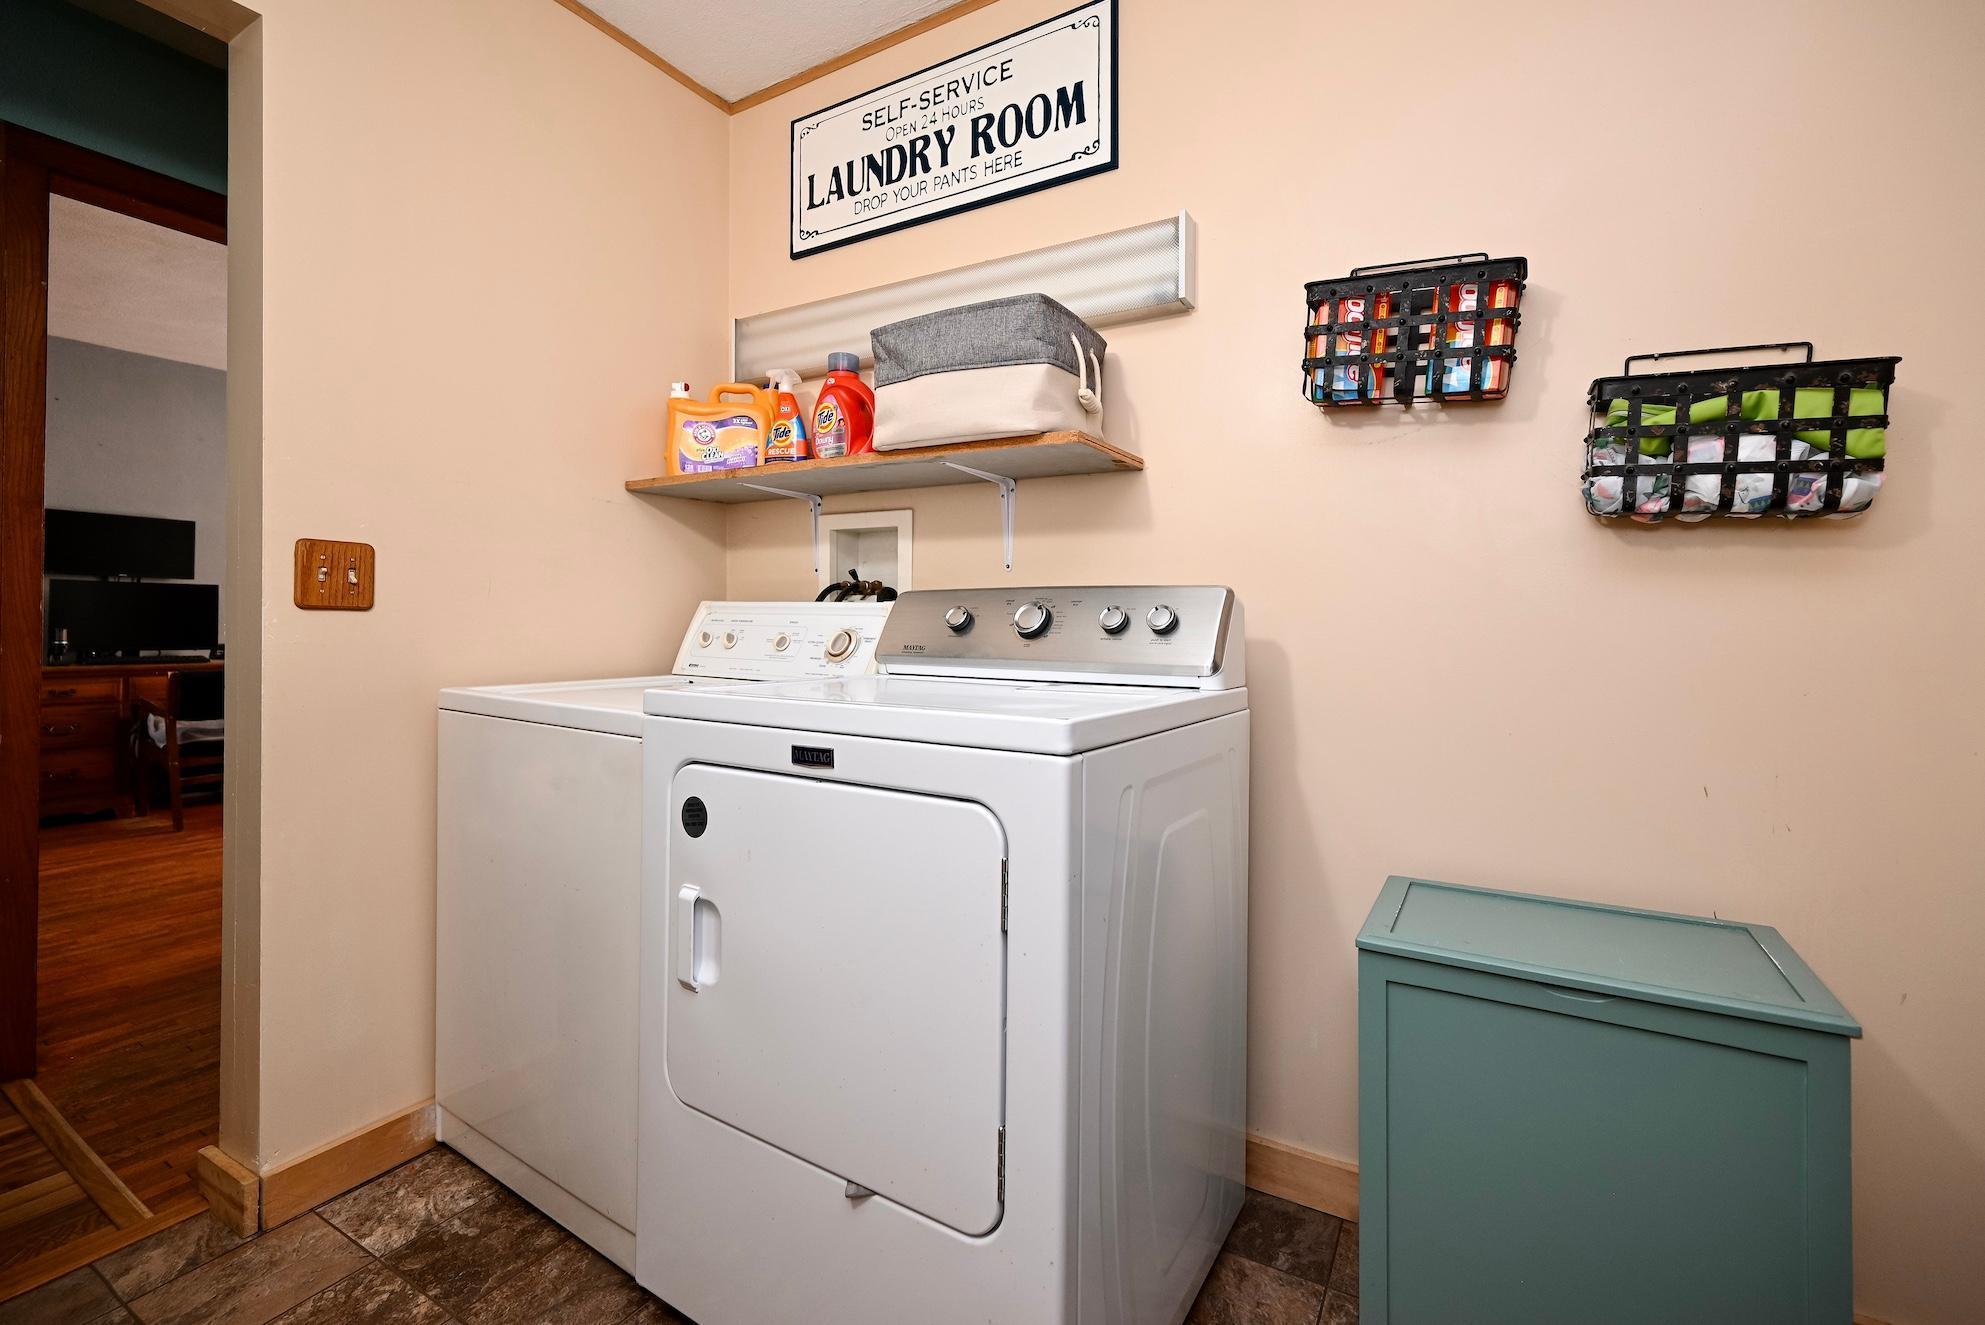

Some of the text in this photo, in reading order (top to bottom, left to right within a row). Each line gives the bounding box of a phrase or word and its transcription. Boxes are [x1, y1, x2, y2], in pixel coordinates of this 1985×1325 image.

[862, 58, 1013, 131] SELF-SERVICE
[885, 96, 985, 142] OPEN 24 HOURS
[807, 80, 1087, 211] LAUNDRY ROOM
[854, 150, 1023, 215] DROP YOUR PANTS HERE
[773, 426, 791, 441] Tide
[817, 409, 834, 428] Tide
[768, 447, 797, 455] RESCUE
[793, 749, 830, 762] MAYTAG
